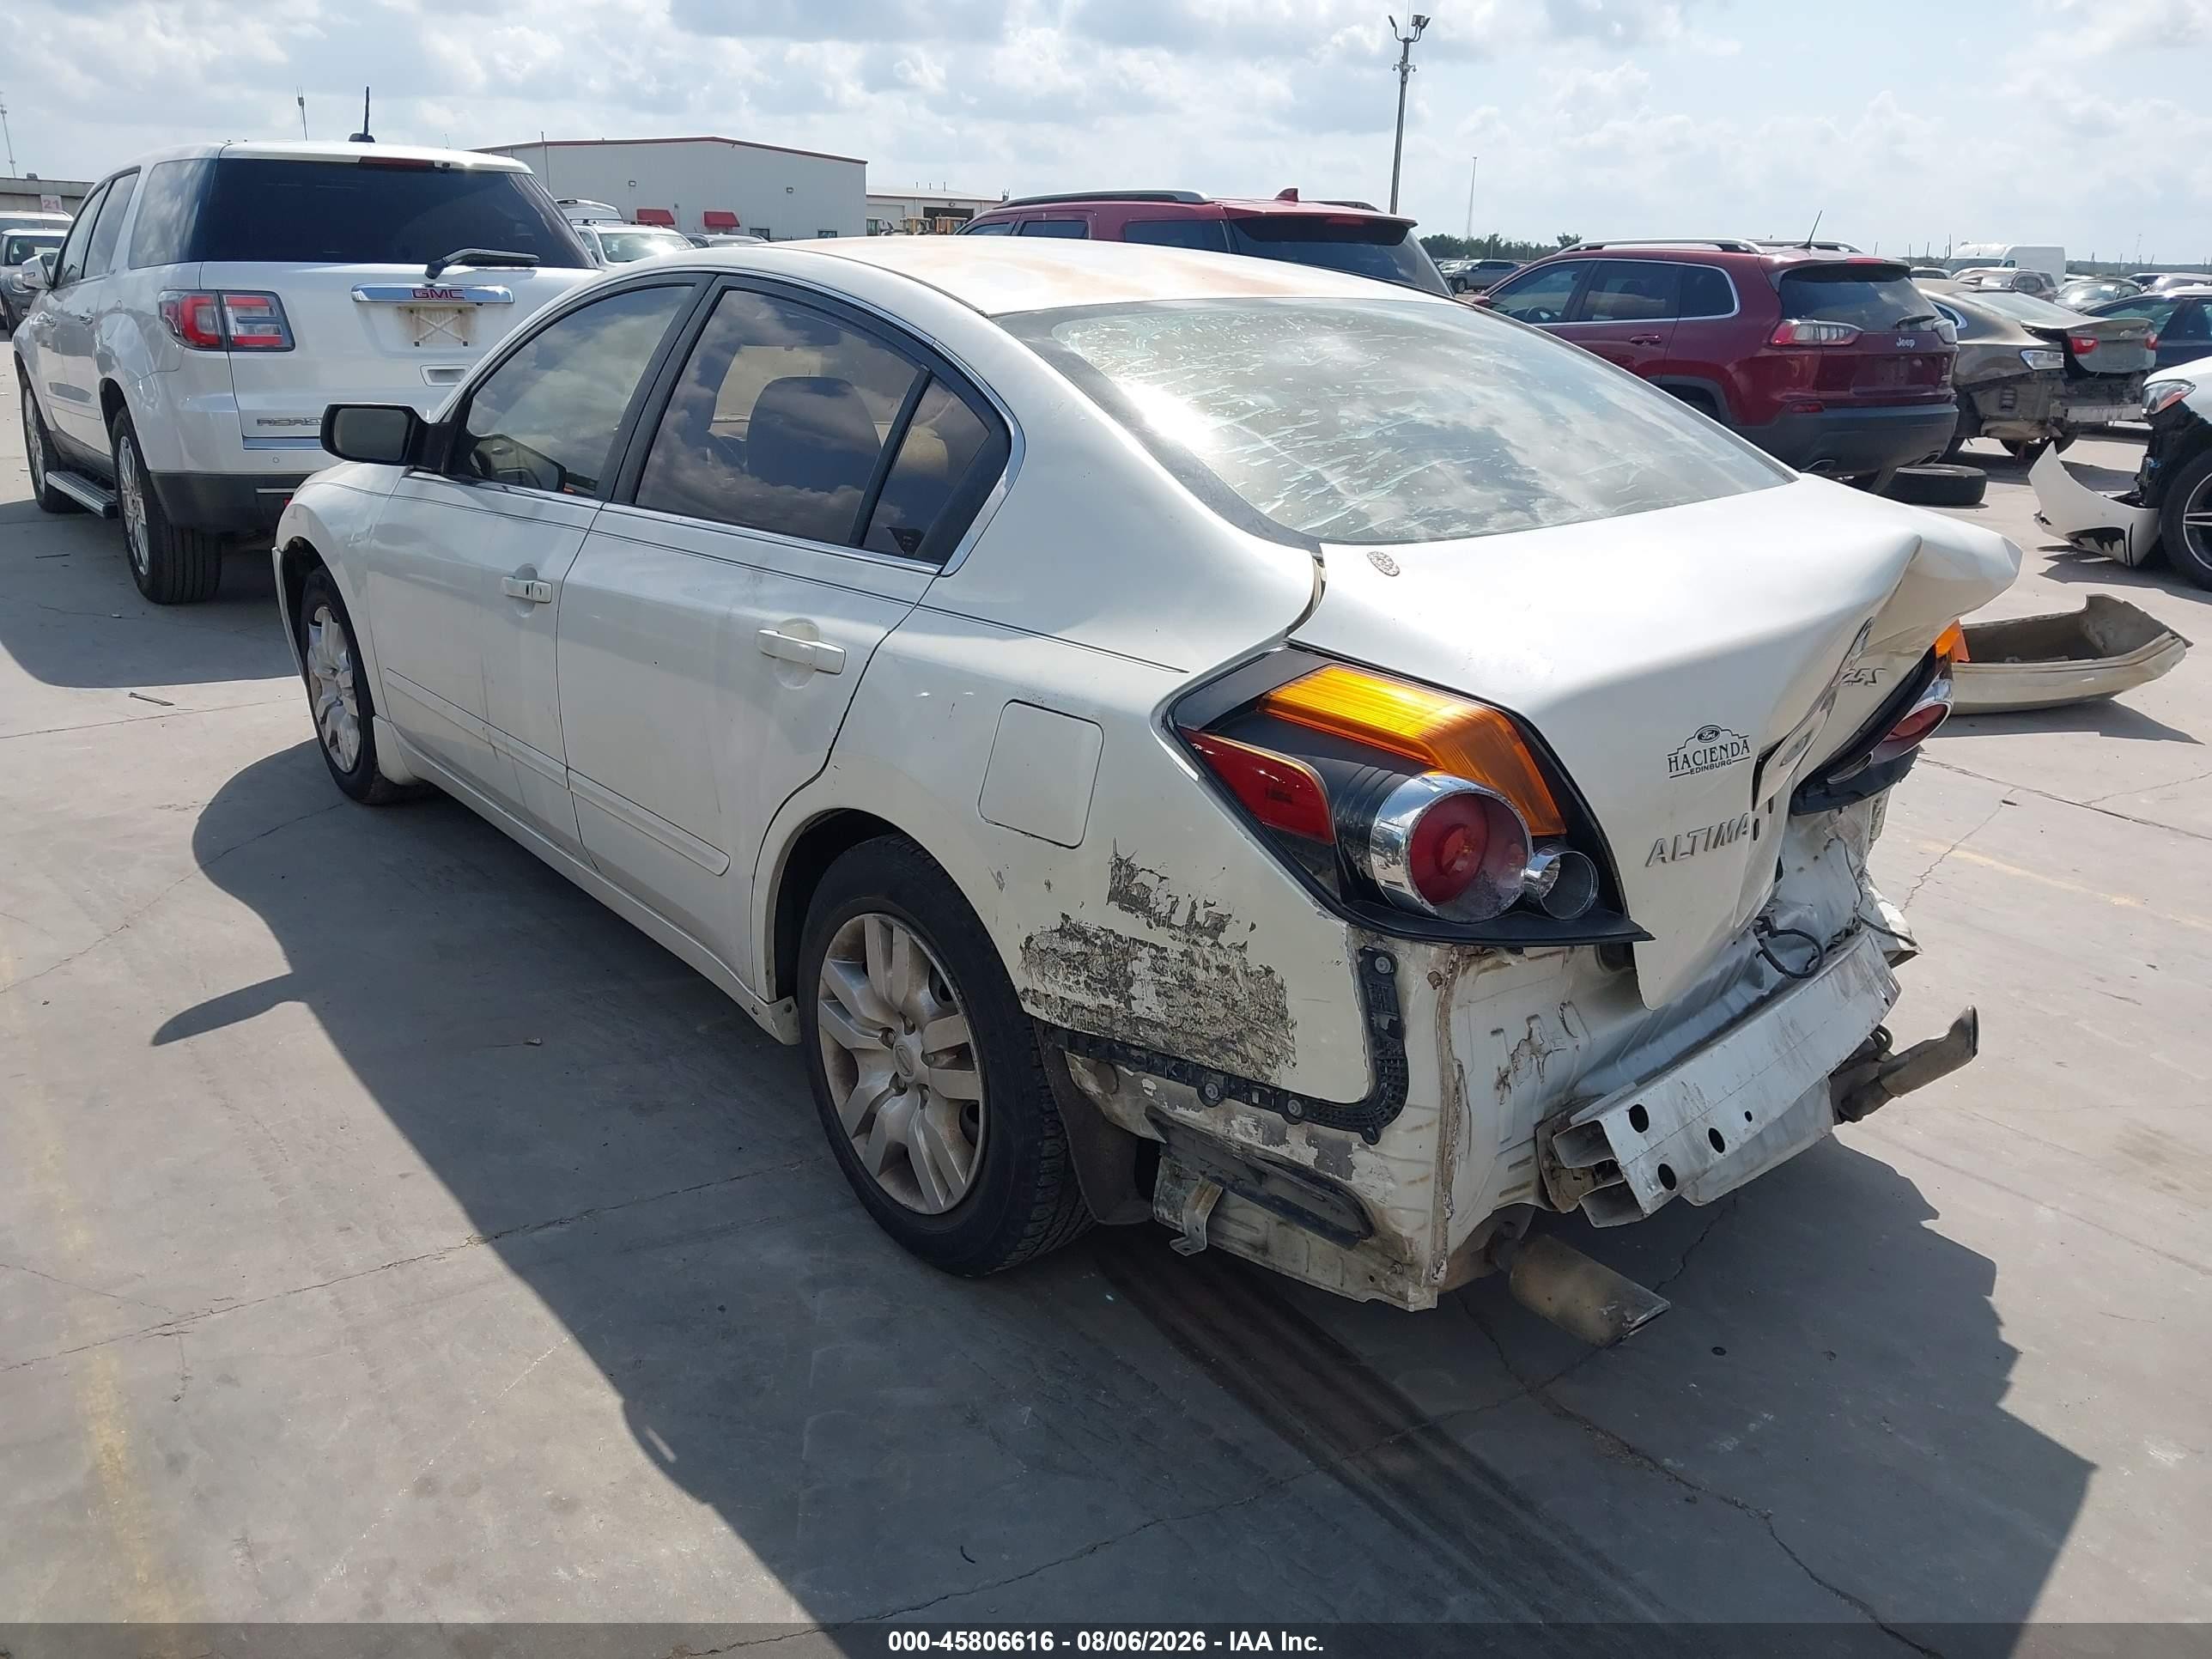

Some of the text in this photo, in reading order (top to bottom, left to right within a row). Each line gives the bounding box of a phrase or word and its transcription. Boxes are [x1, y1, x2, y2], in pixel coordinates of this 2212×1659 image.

[411, 289, 465, 301] GMC
[1896, 337, 1916, 349] Jeep
[1668, 738, 1750, 773] HACIENDA
[1690, 759, 1732, 775] EDINBURG
[1644, 812, 1750, 867] ALTIMA
